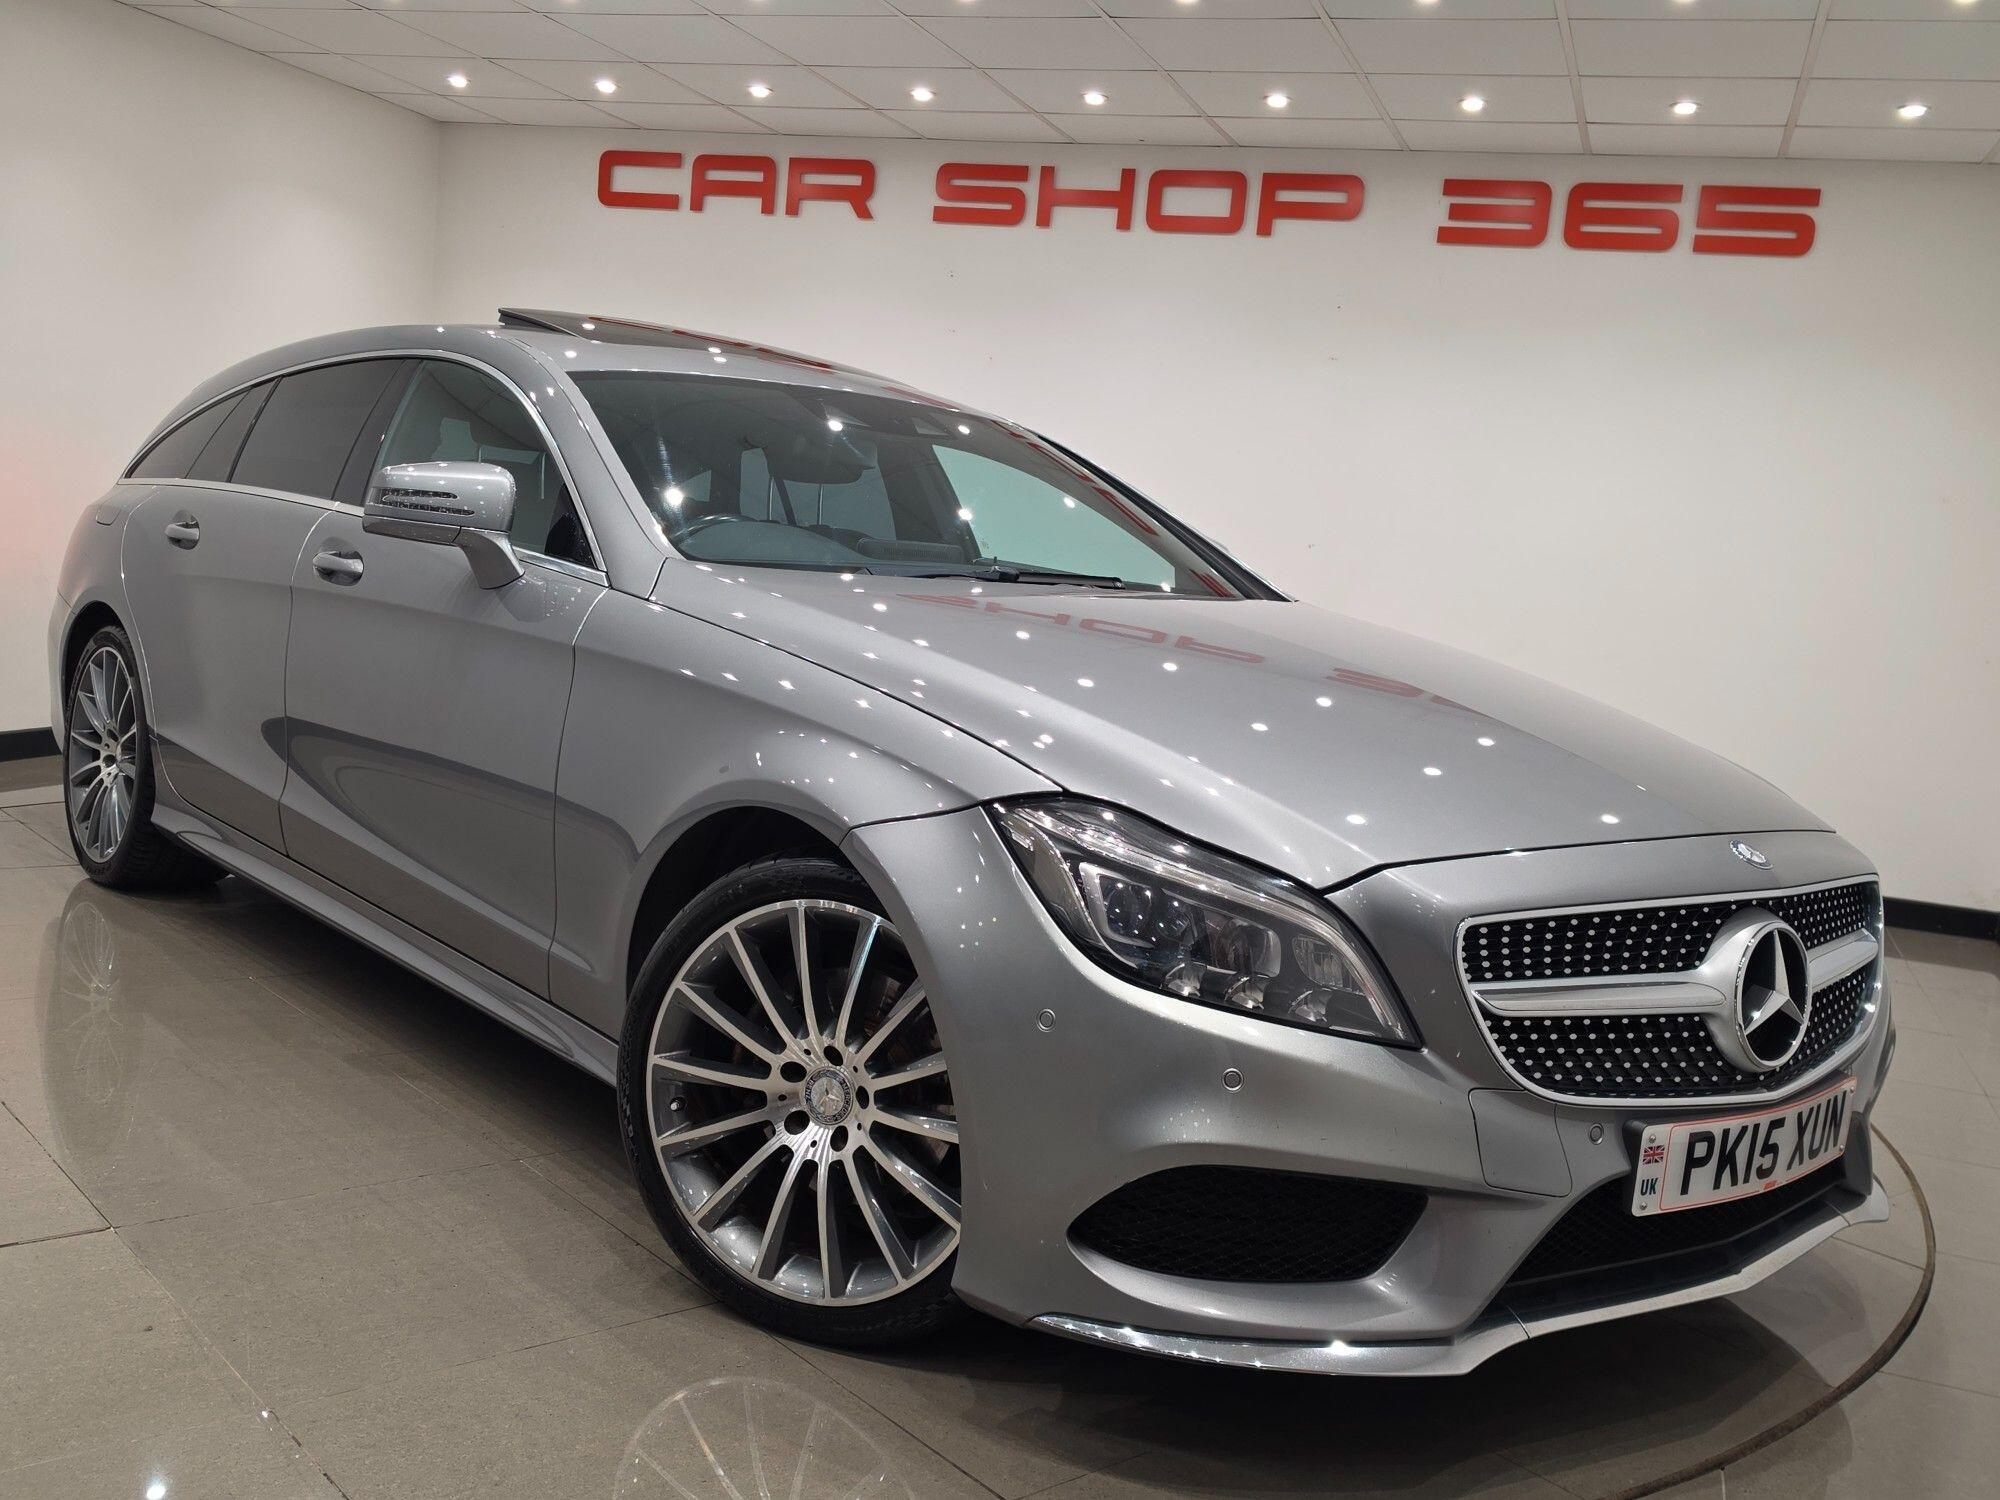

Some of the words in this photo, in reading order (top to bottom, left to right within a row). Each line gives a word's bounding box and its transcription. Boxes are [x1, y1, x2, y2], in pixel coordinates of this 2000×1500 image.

[597, 150, 876, 220] CAR
[932, 162, 1364, 236] SHOP
[1437, 179, 1821, 257] 365
[1640, 1177, 1658, 1196] UK
[1680, 1116, 1786, 1196] PK15
[1786, 1090, 1848, 1171] XUN
